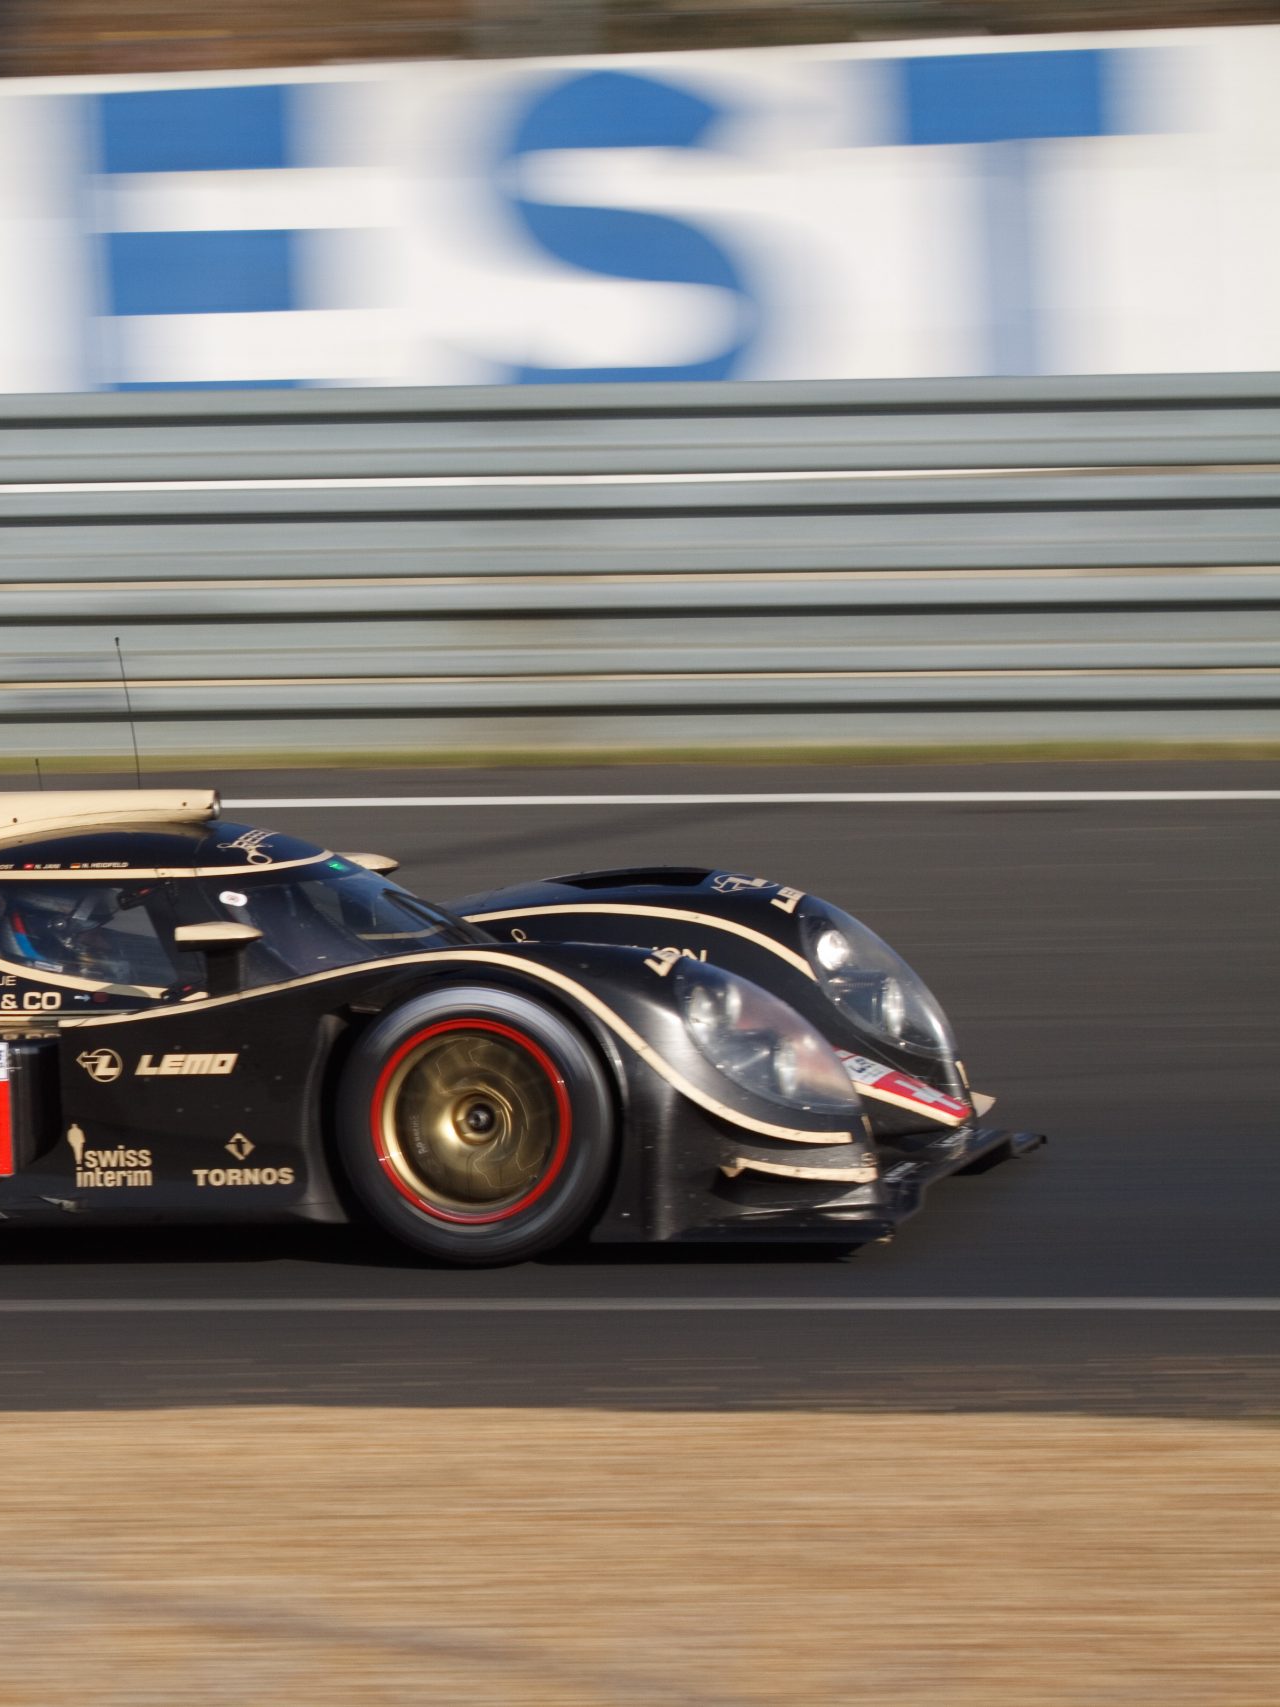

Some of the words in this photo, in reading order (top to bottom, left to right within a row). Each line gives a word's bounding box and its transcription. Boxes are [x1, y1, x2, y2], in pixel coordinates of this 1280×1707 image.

[0, 993, 18, 1010] &
[23, 991, 62, 1010] CO
[134, 1053, 239, 1076] LEMO
[84, 1145, 152, 1168] swiss
[75, 1167, 153, 1188] interim
[192, 1167, 296, 1187] TORNOS
